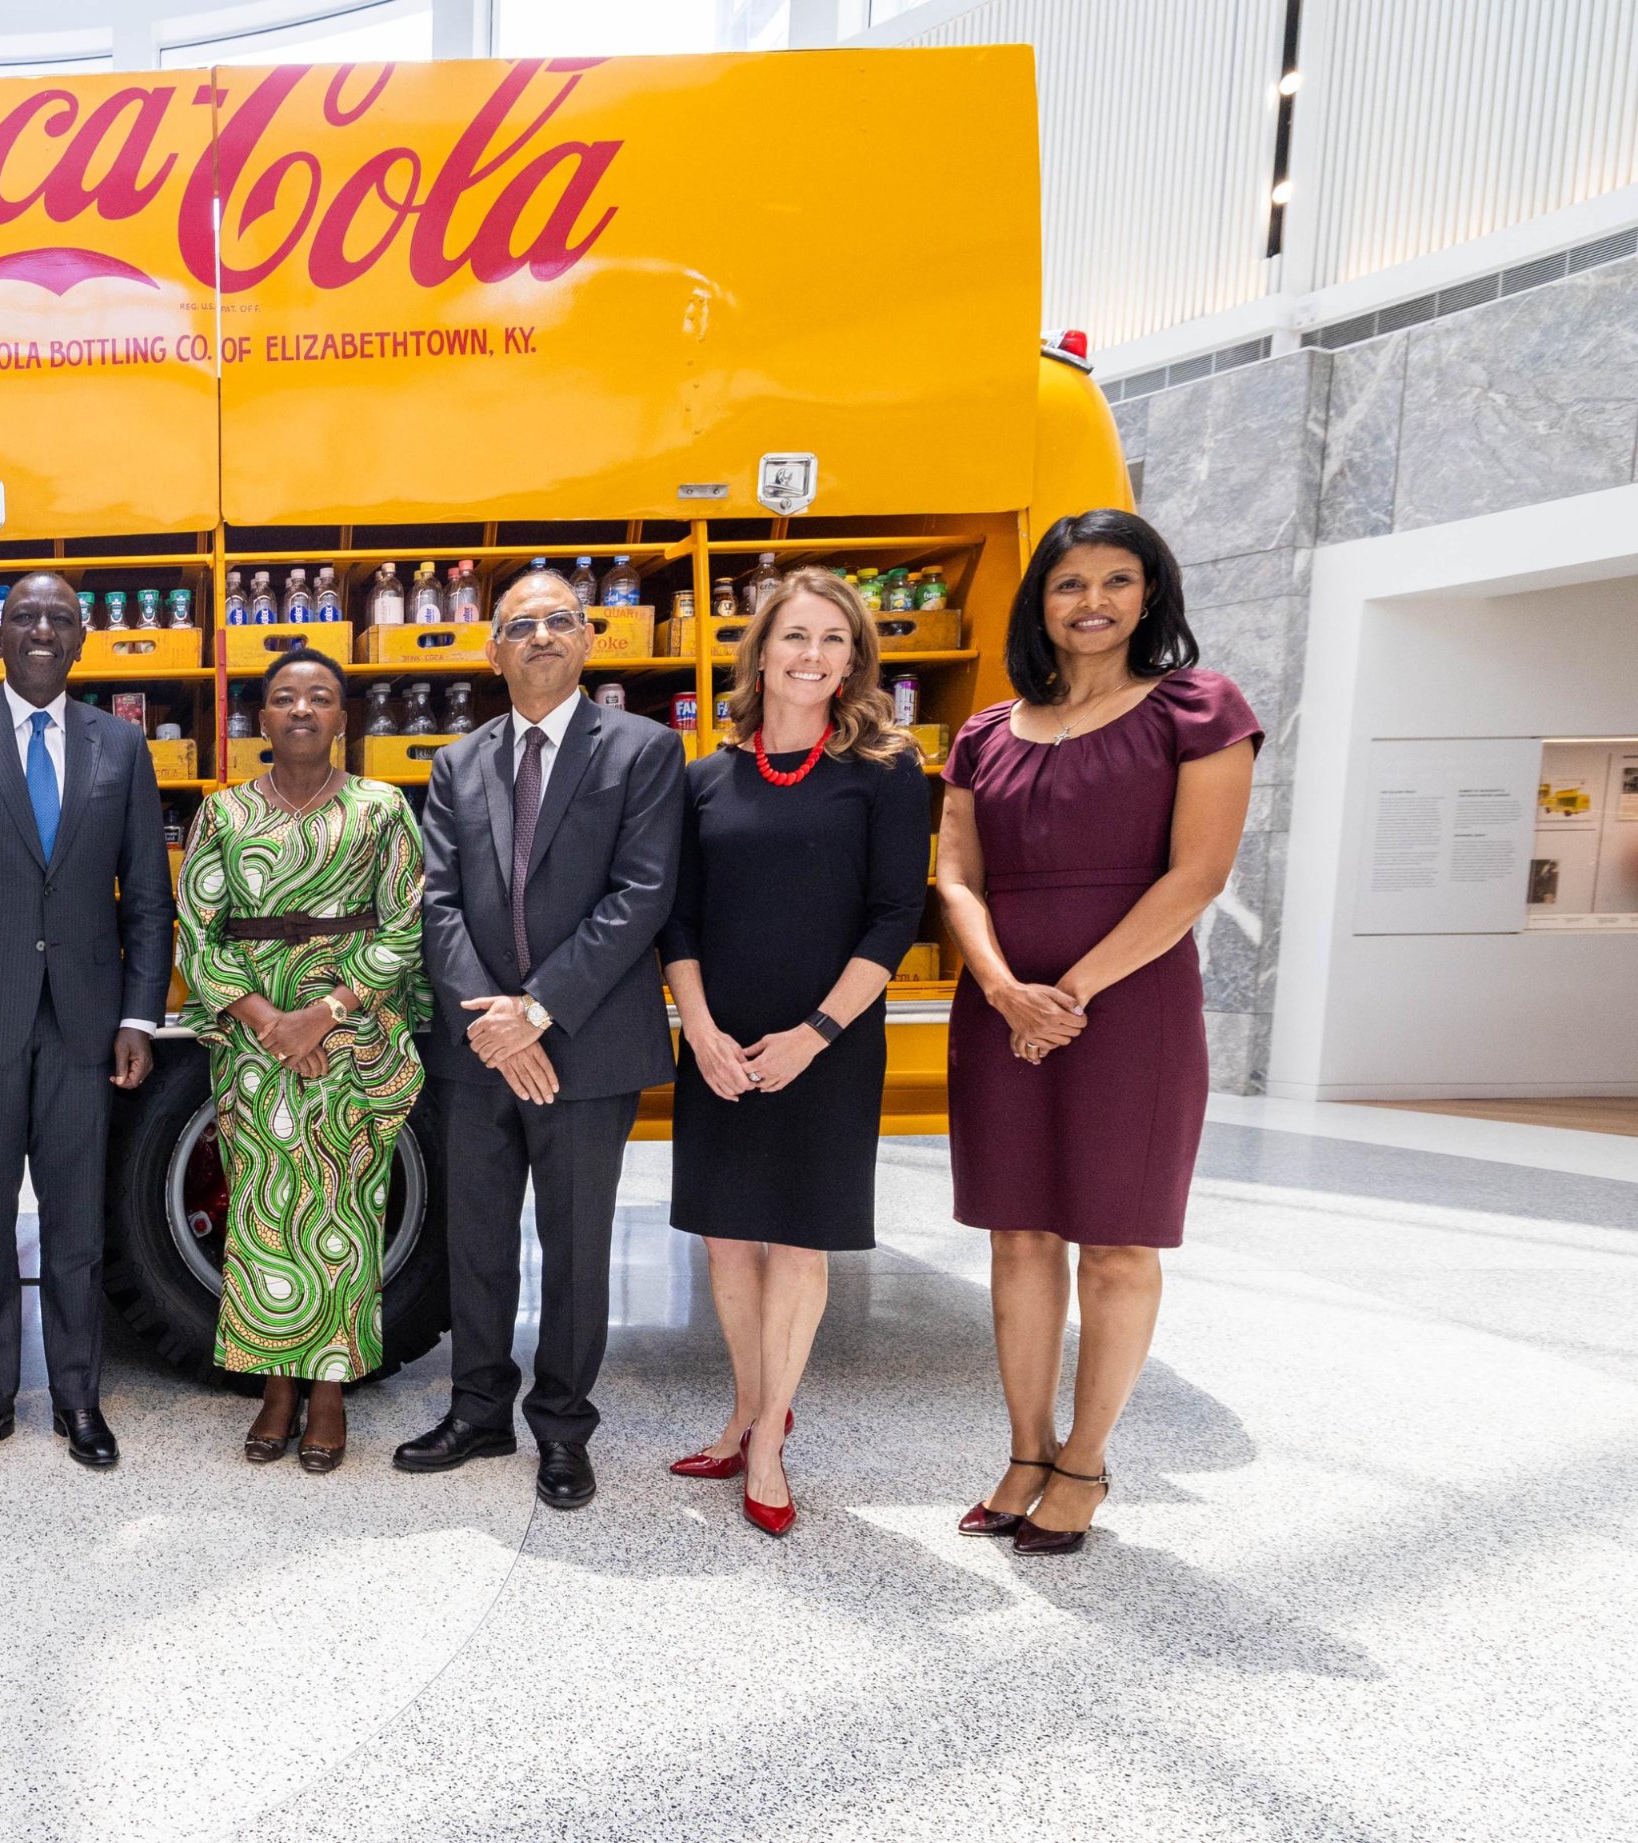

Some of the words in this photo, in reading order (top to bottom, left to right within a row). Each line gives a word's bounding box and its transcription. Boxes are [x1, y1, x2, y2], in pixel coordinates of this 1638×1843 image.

[50, 335, 167, 368] BOTTLING
[175, 334, 212, 363] CO.
[221, 336, 252, 364] OF
[265, 327, 495, 362] ELIZABETHTOWN,
[504, 326, 537, 355] KY.
[593, 636, 628, 650] oke
